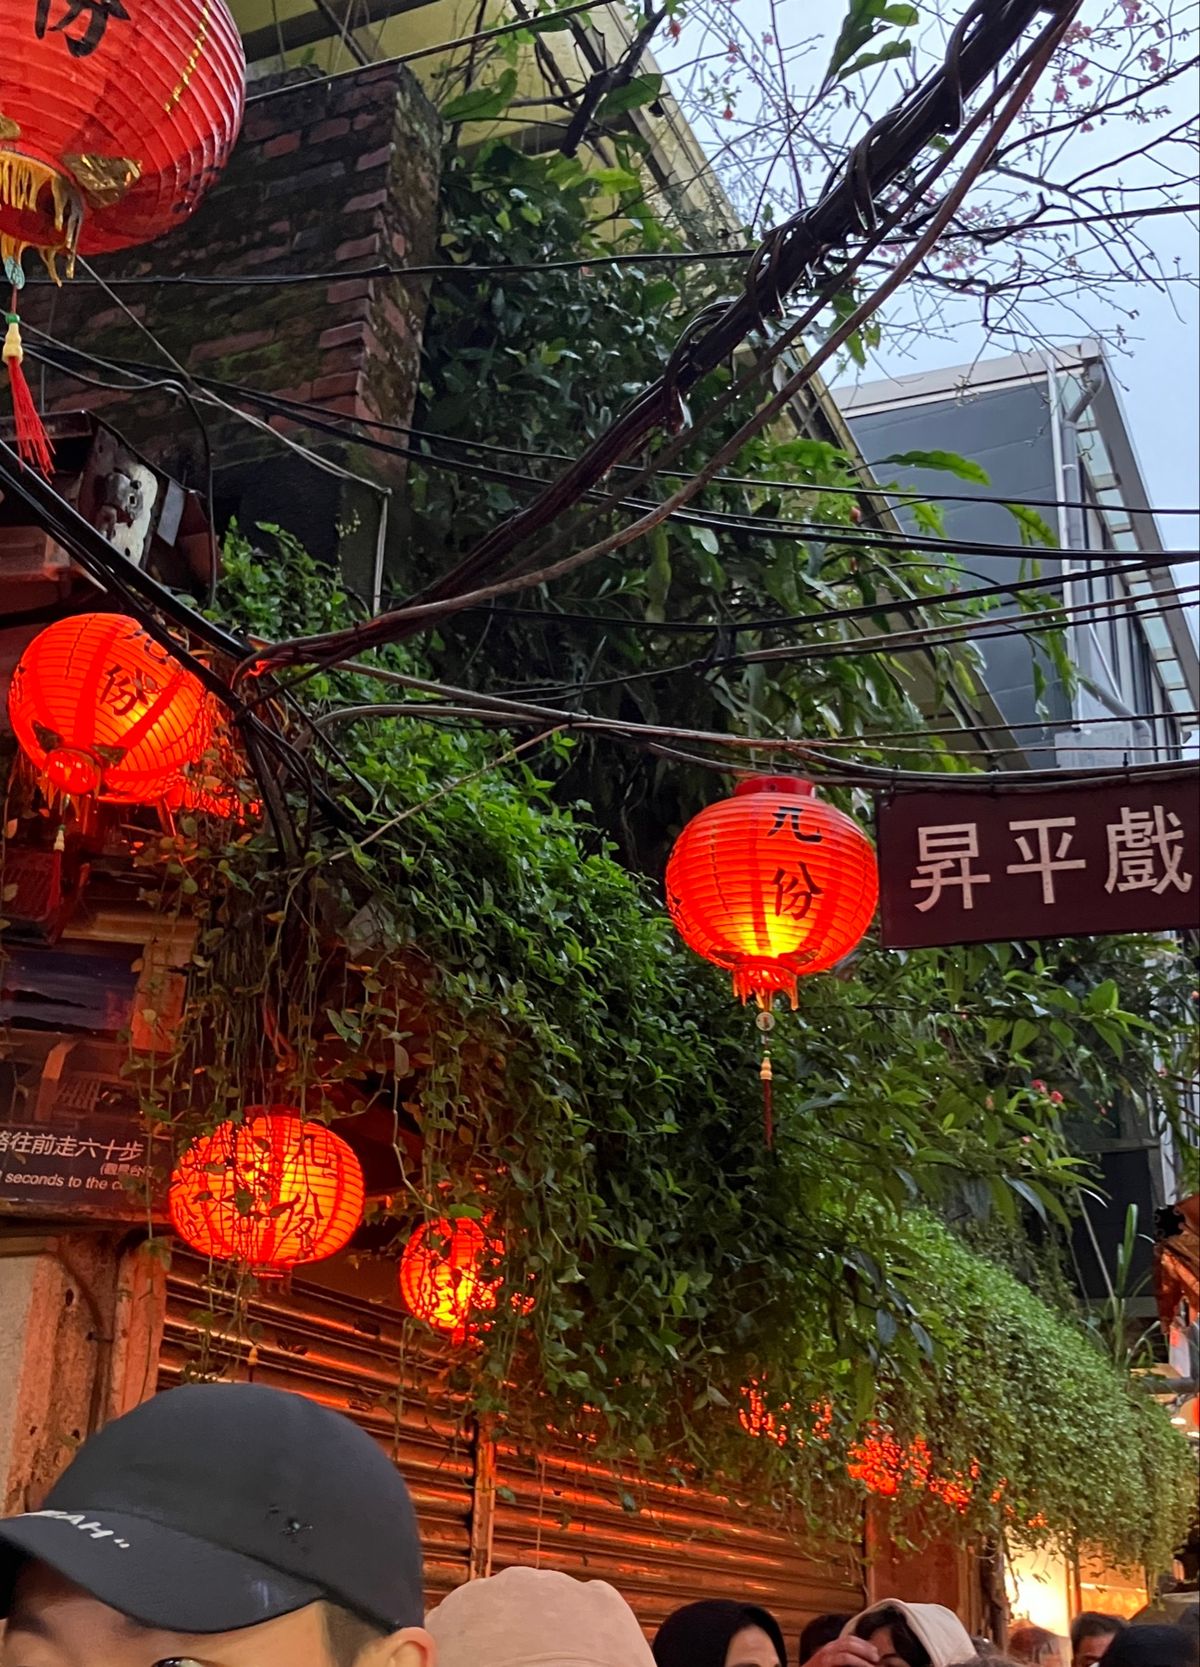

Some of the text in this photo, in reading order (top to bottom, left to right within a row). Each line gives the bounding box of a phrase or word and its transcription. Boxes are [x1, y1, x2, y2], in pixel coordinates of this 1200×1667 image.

[910, 805, 1193, 912] 昇平戲
[5, 1172, 64, 1187] seconds
[68, 1175, 81, 1188] to
[85, 1177, 108, 1190] the
